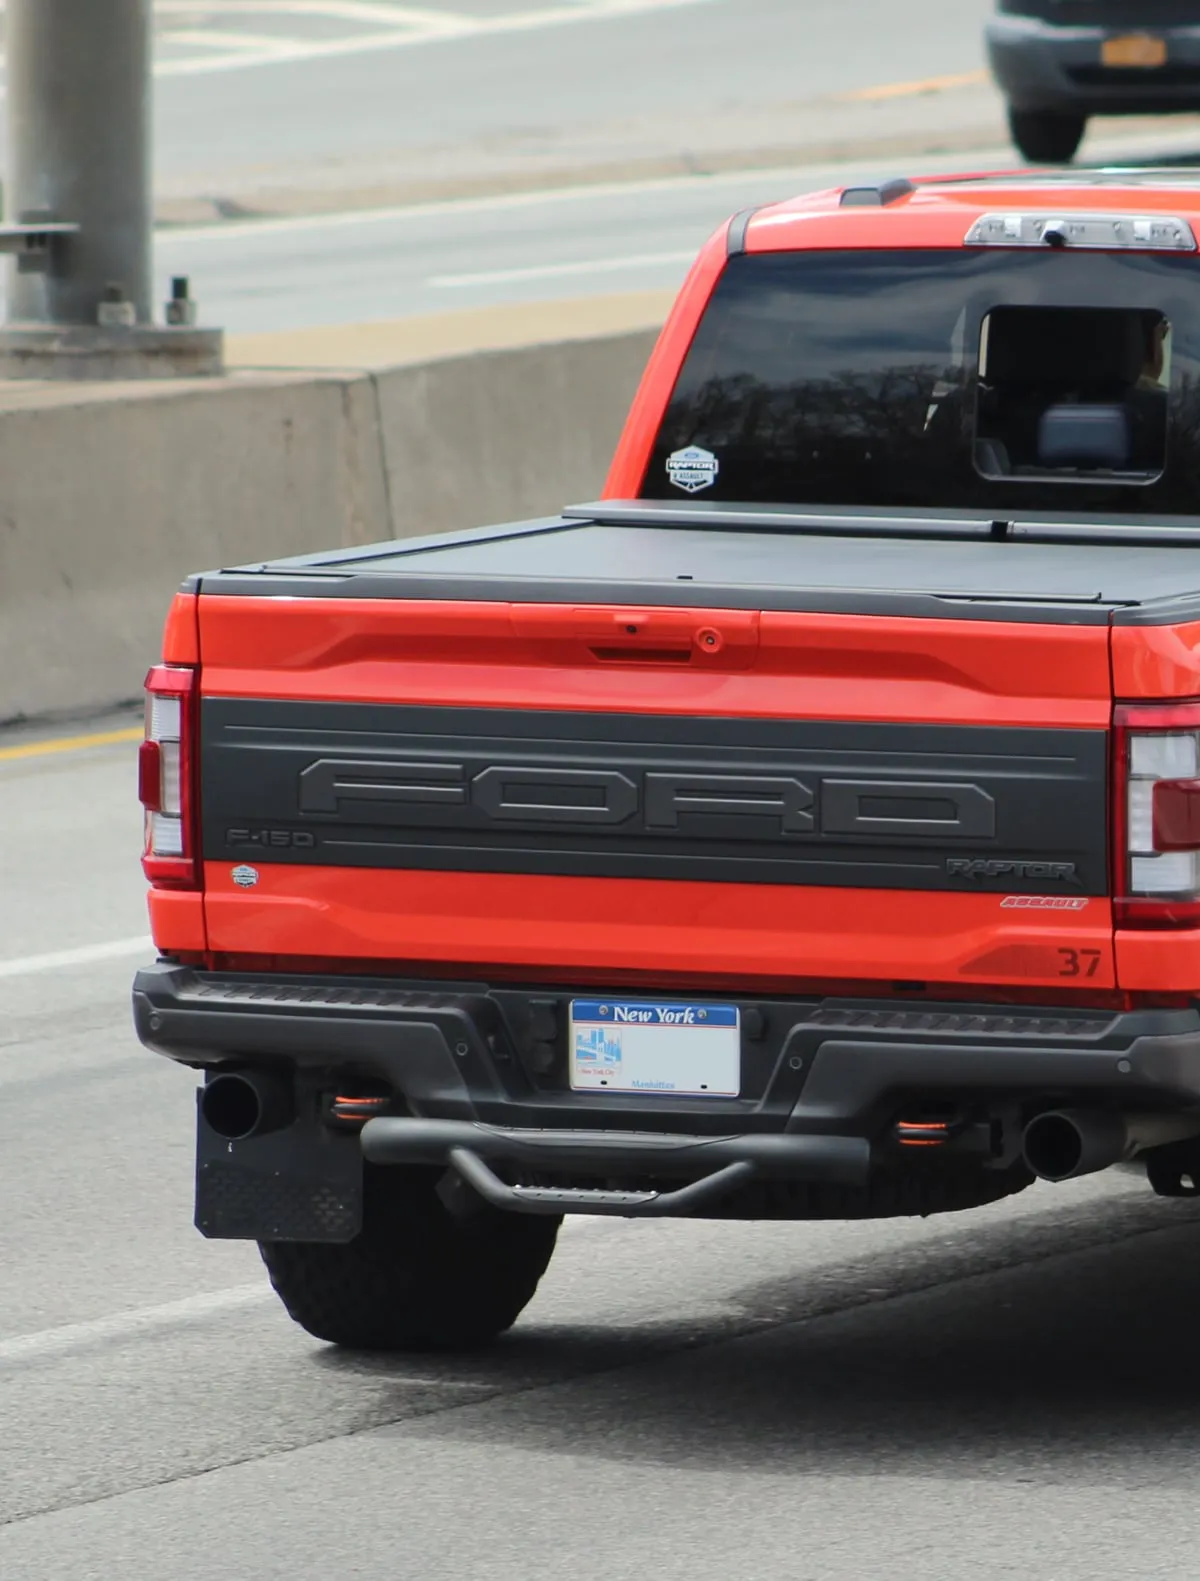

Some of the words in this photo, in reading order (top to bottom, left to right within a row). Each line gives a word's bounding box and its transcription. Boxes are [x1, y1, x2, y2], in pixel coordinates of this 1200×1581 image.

[299, 758, 996, 838] FORD
[226, 828, 315, 848] F-150
[946, 858, 1085, 888] RAPTOR
[1057, 947, 1102, 977] 37
[613, 1006, 652, 1022] New
[655, 1007, 695, 1024] York
